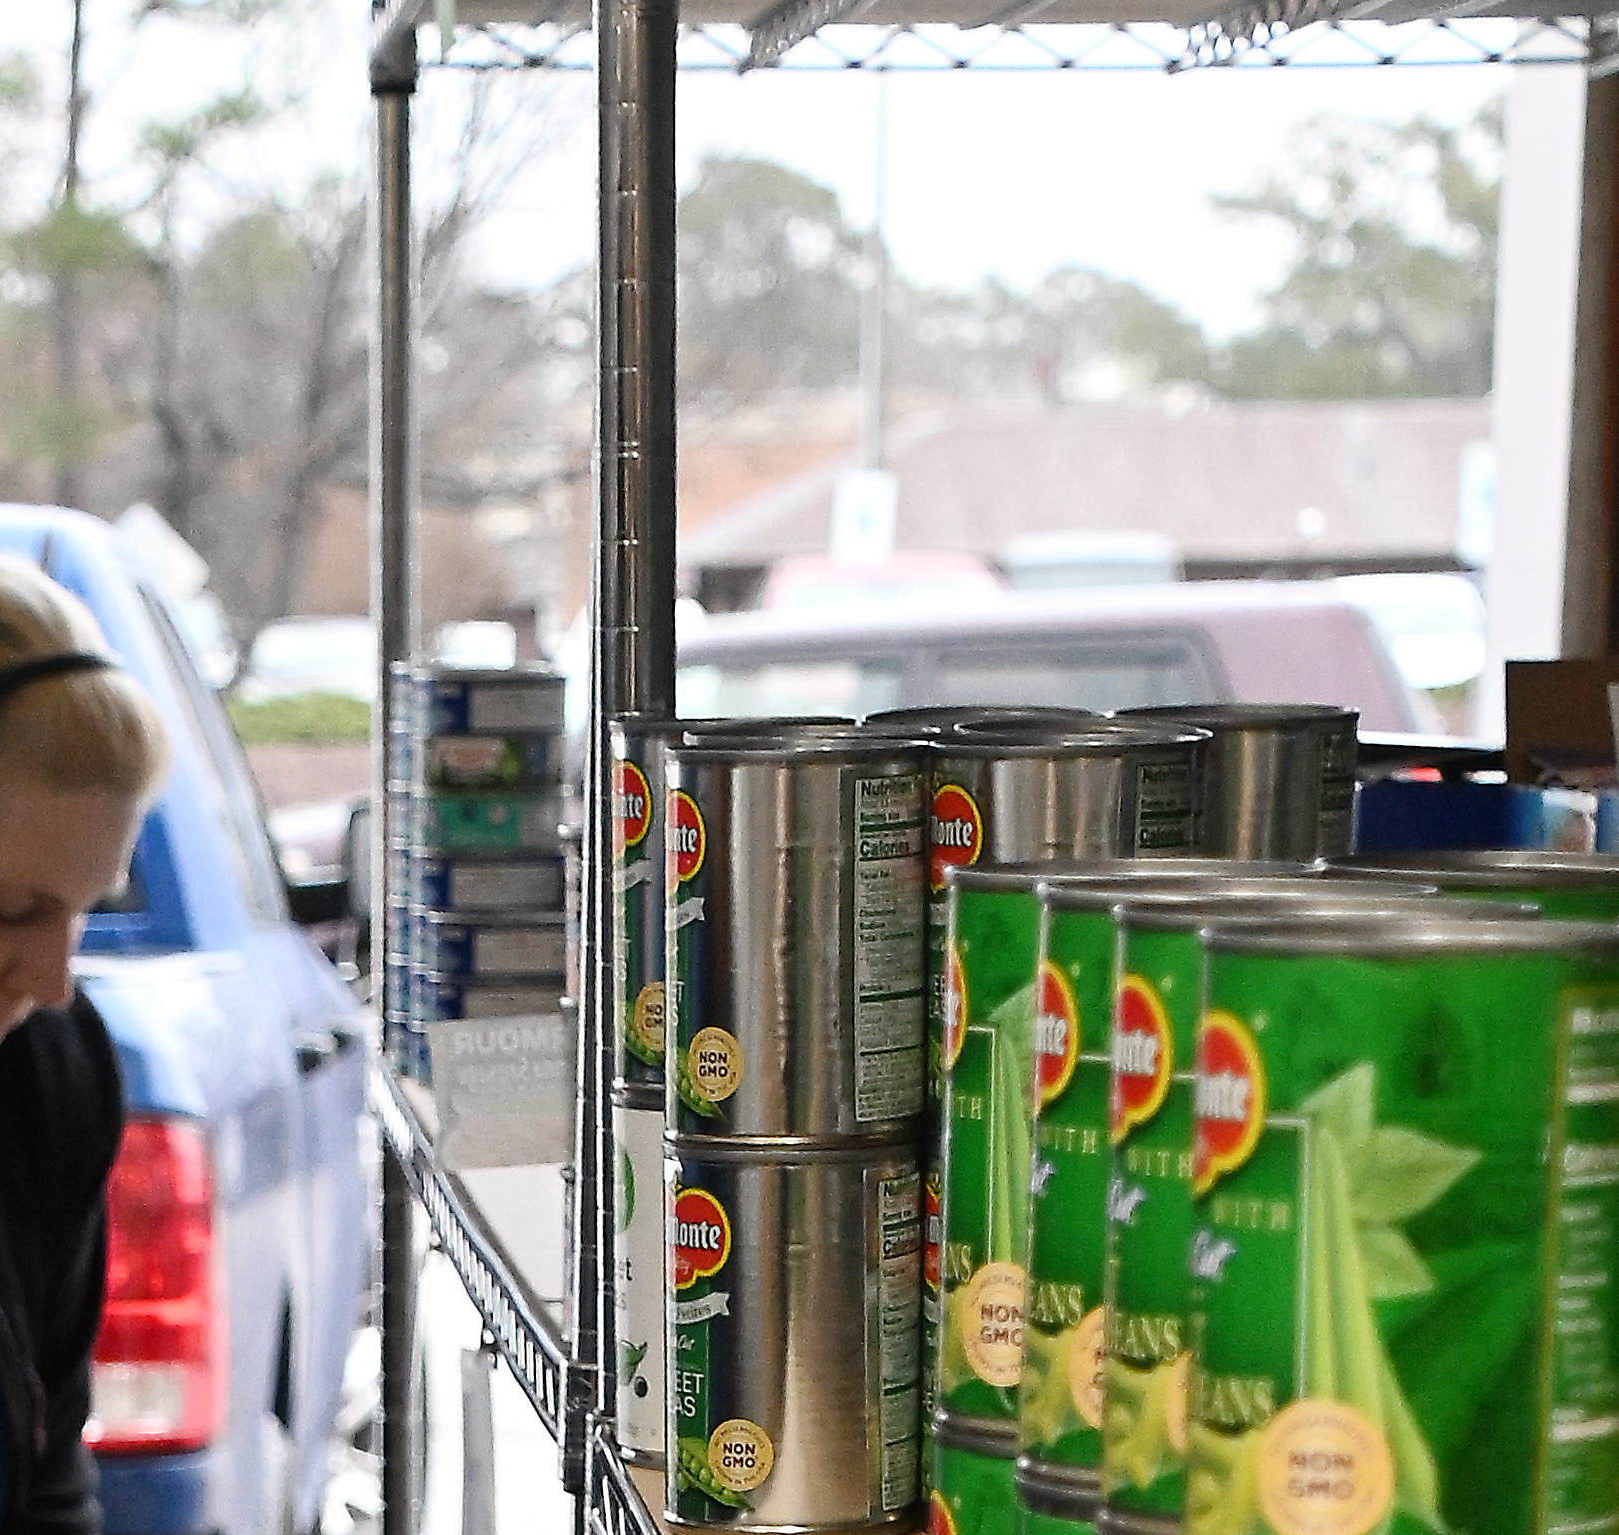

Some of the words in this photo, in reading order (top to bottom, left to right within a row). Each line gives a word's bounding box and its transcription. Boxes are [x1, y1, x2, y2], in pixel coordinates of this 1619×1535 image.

[699, 1051, 728, 1063] NON
[699, 1065, 728, 1078] GMO
[723, 1444, 756, 1455] NON
[723, 1457, 756, 1468] GMO
[1288, 1452, 1355, 1471] NON
